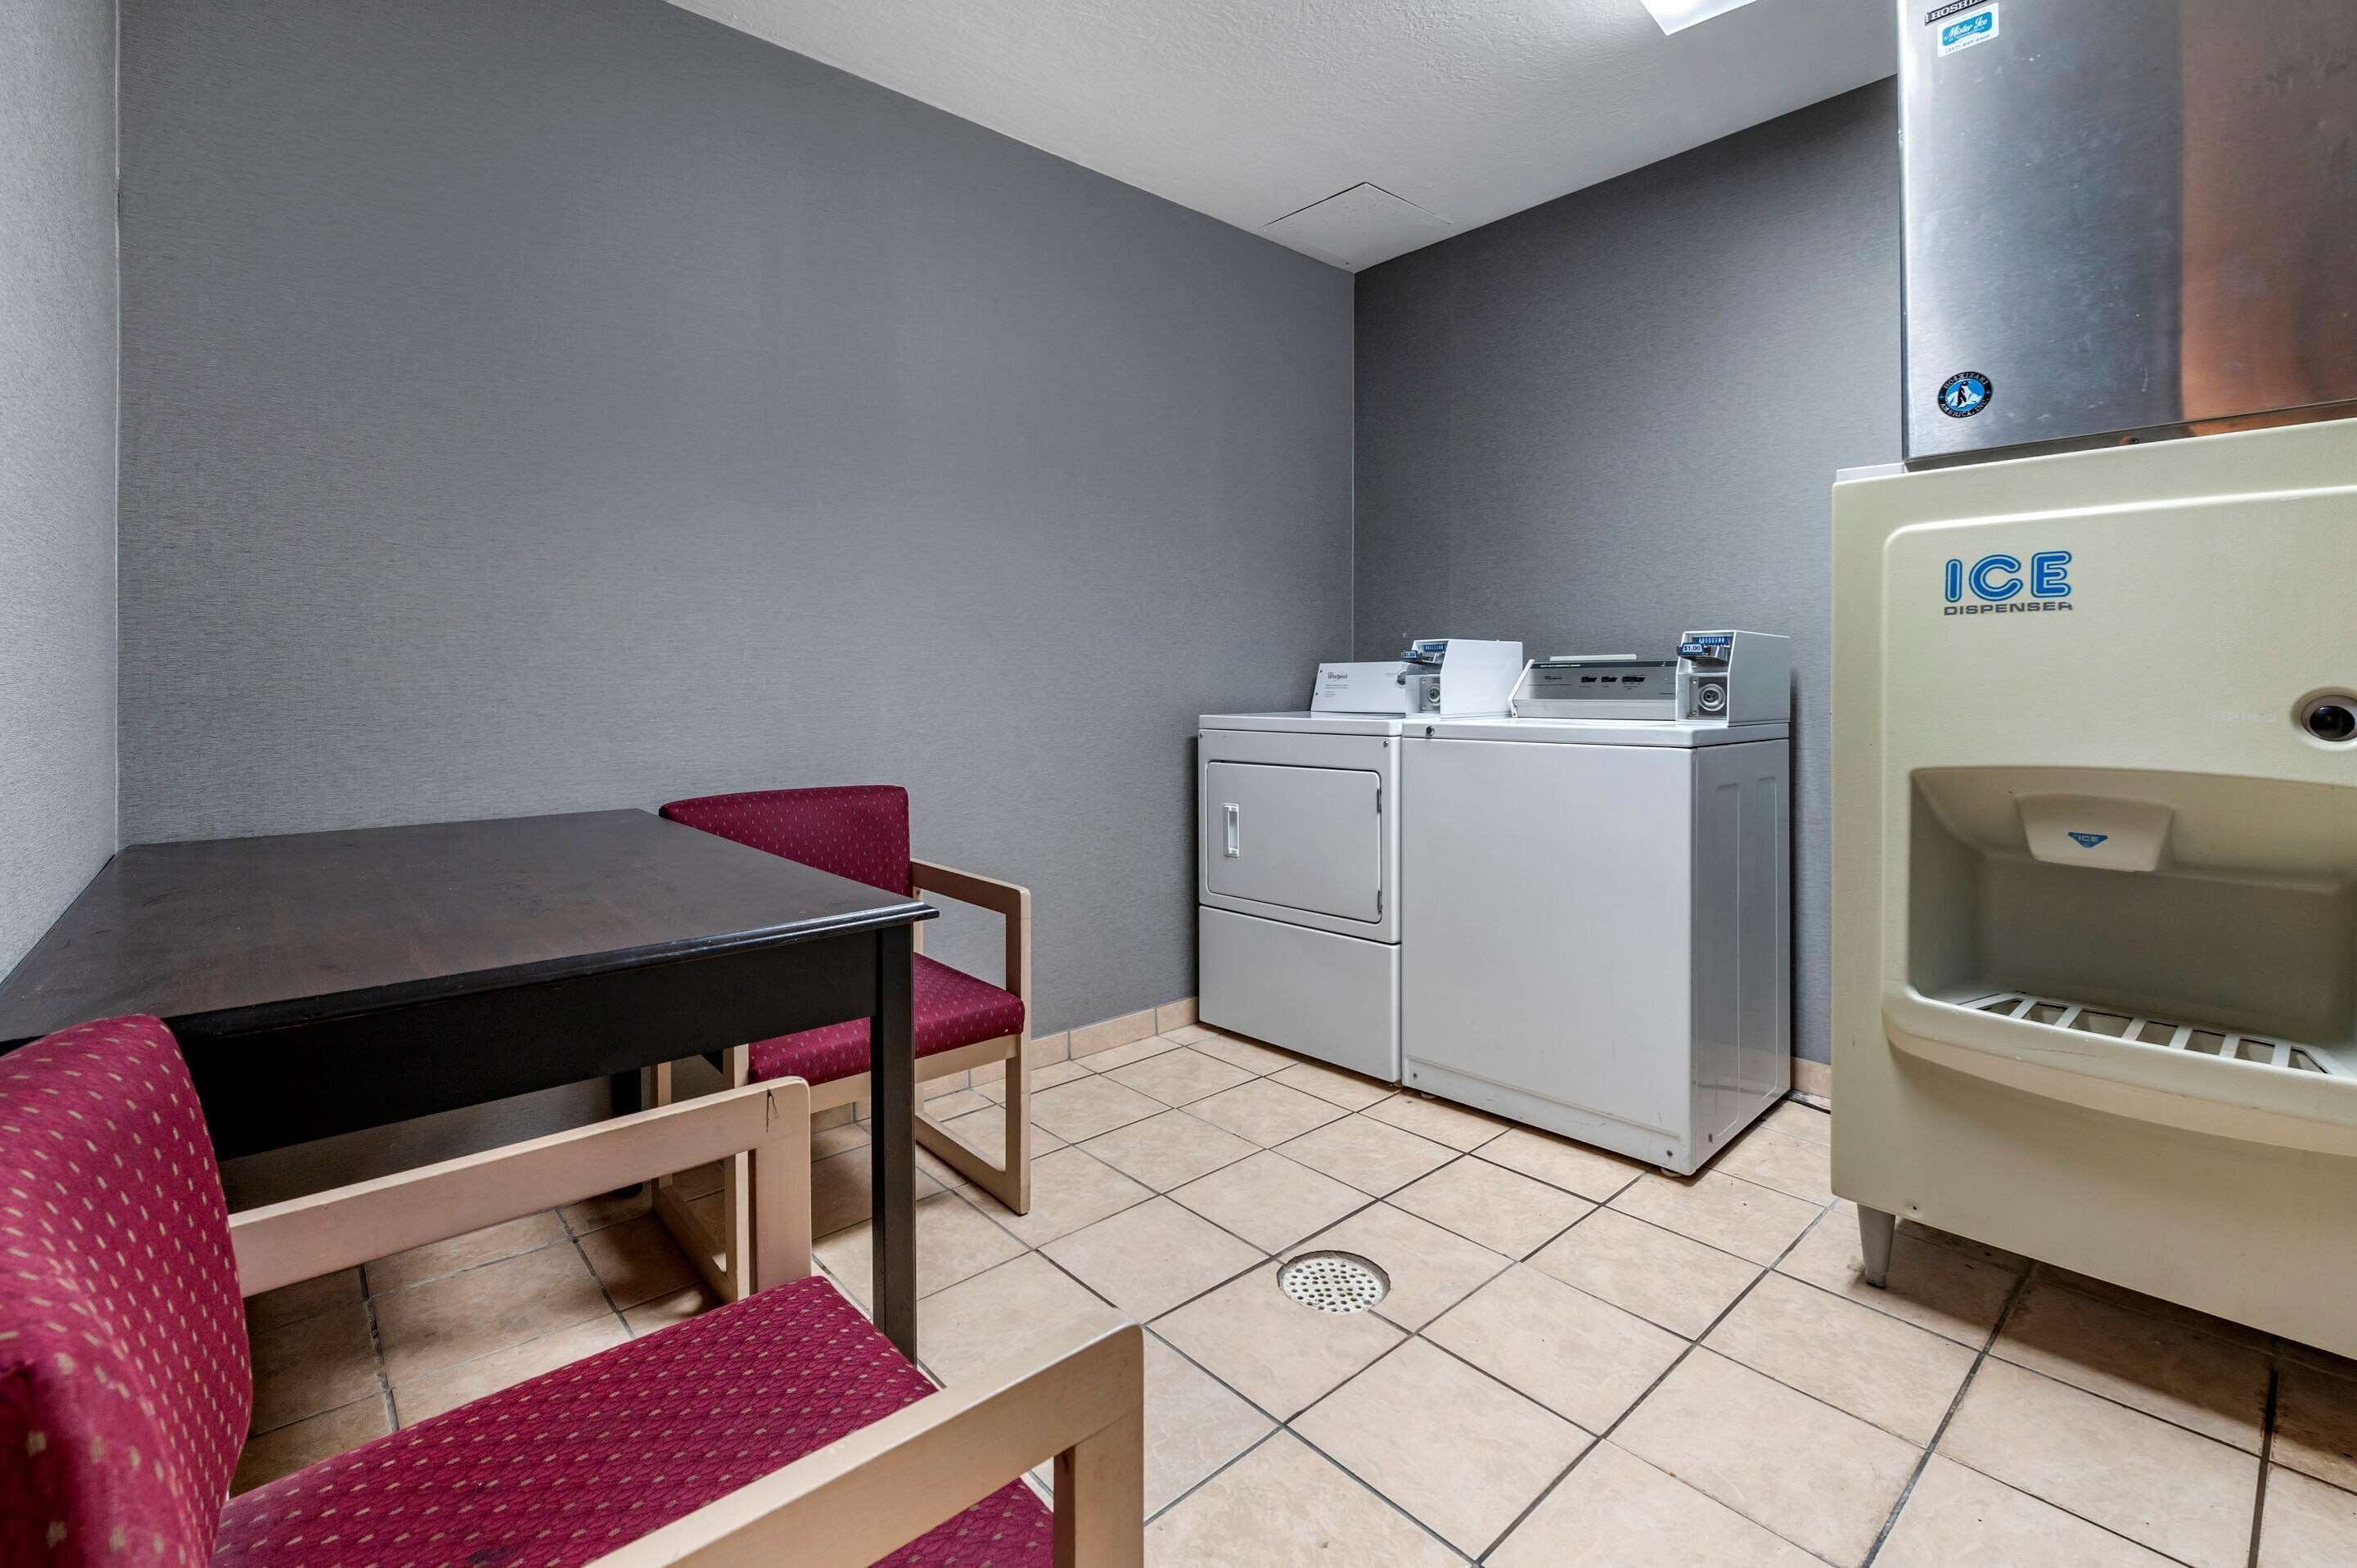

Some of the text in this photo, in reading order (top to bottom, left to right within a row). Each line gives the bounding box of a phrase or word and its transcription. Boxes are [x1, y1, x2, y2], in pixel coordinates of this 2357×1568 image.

[1945, 551, 2072, 603] ICE
[1944, 602, 2073, 615] DISPENSER
[1683, 644, 1701, 652] $1.00
